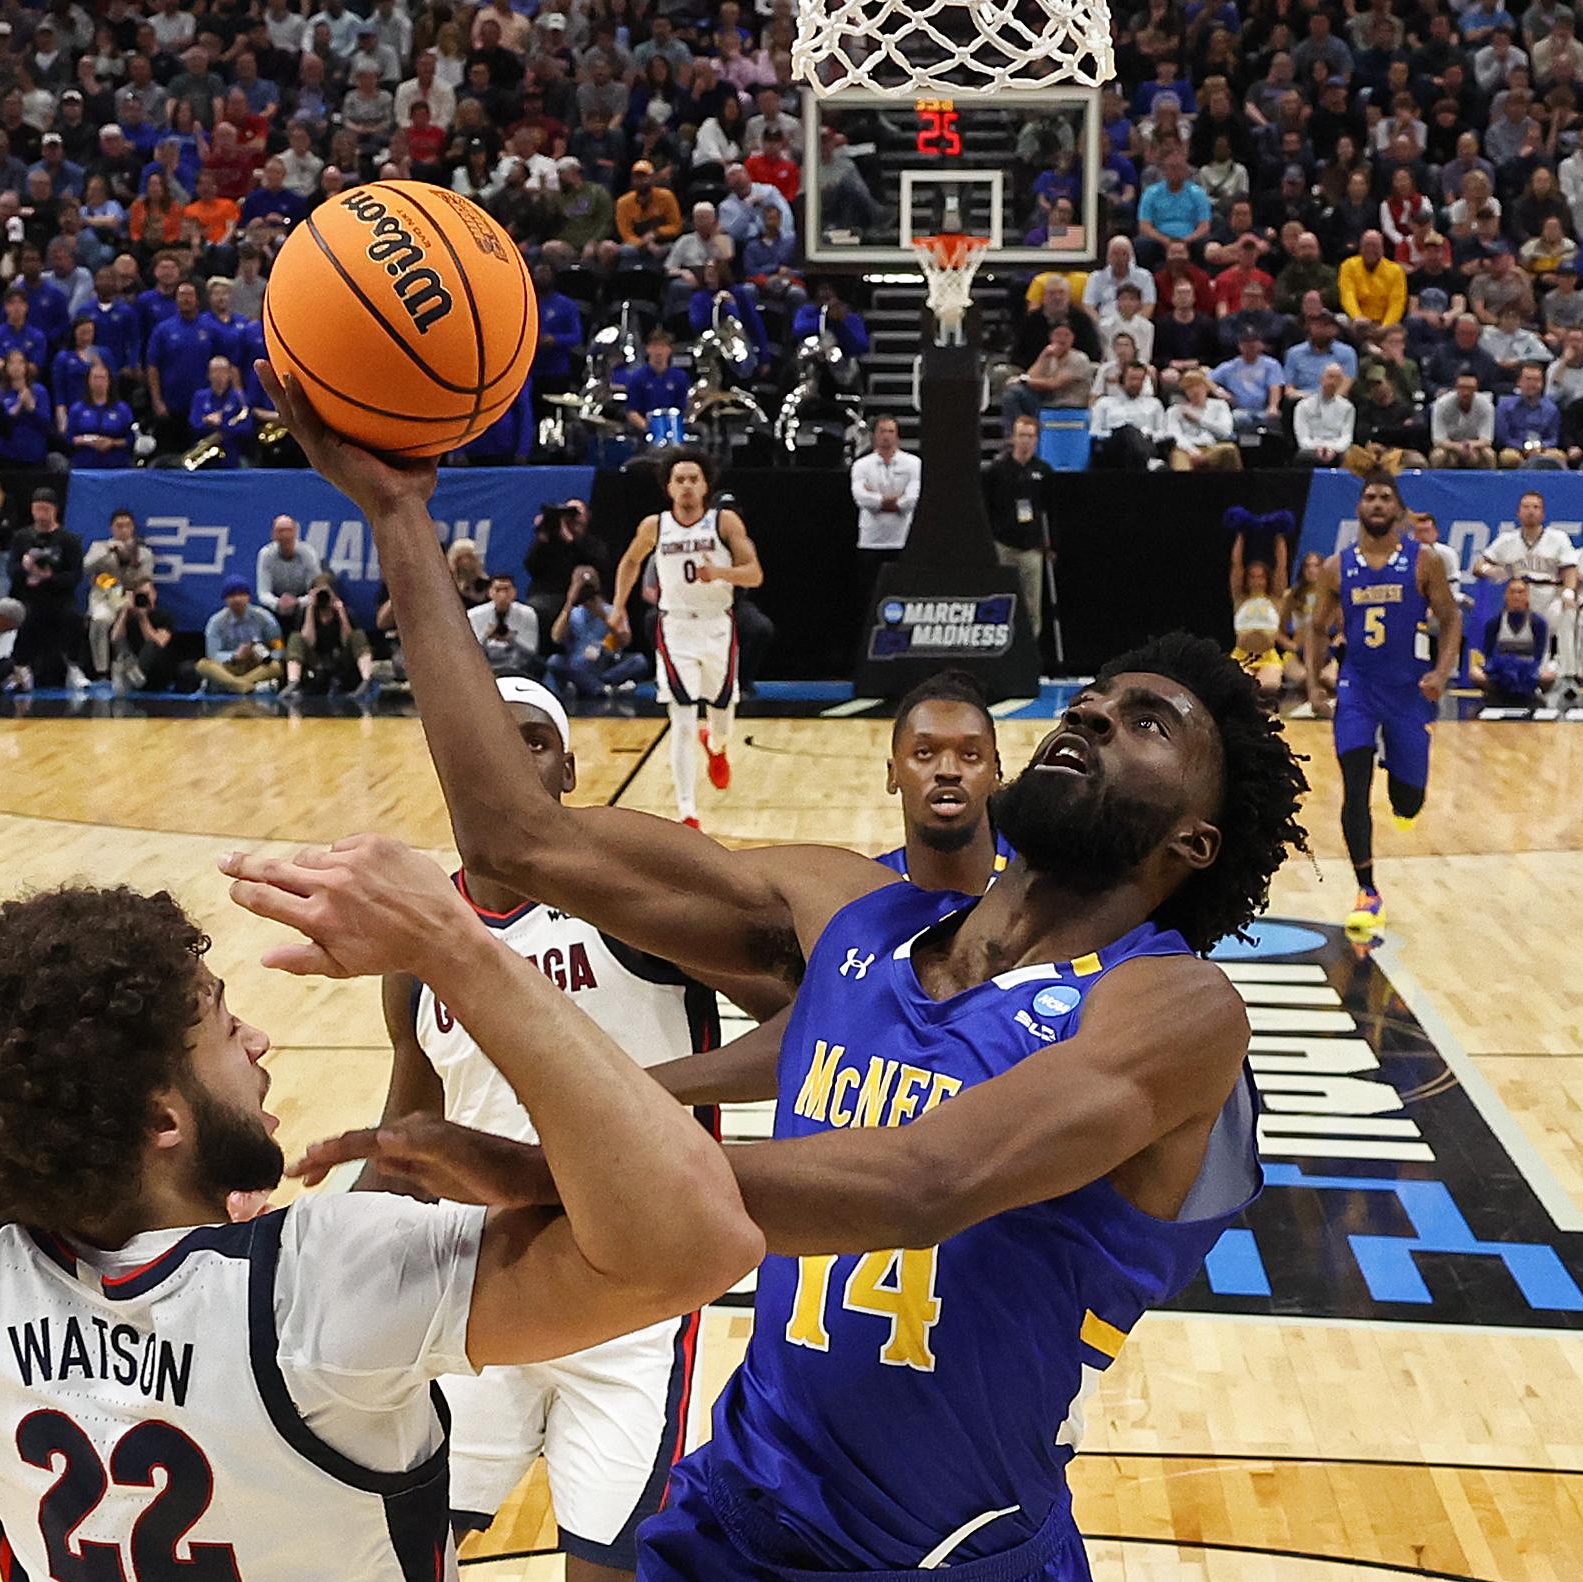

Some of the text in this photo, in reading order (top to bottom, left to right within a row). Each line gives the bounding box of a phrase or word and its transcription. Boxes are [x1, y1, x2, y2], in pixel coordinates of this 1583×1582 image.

[917, 112, 961, 155] 25
[339, 189, 453, 337] Wilson
[683, 559, 698, 583] 0
[902, 602, 977, 624] MARCH
[1364, 606, 1386, 648] 5
[911, 623, 1010, 647] MADNESS
[785, 1244, 942, 1373] 14
[7, 1315, 194, 1407] WATSON
